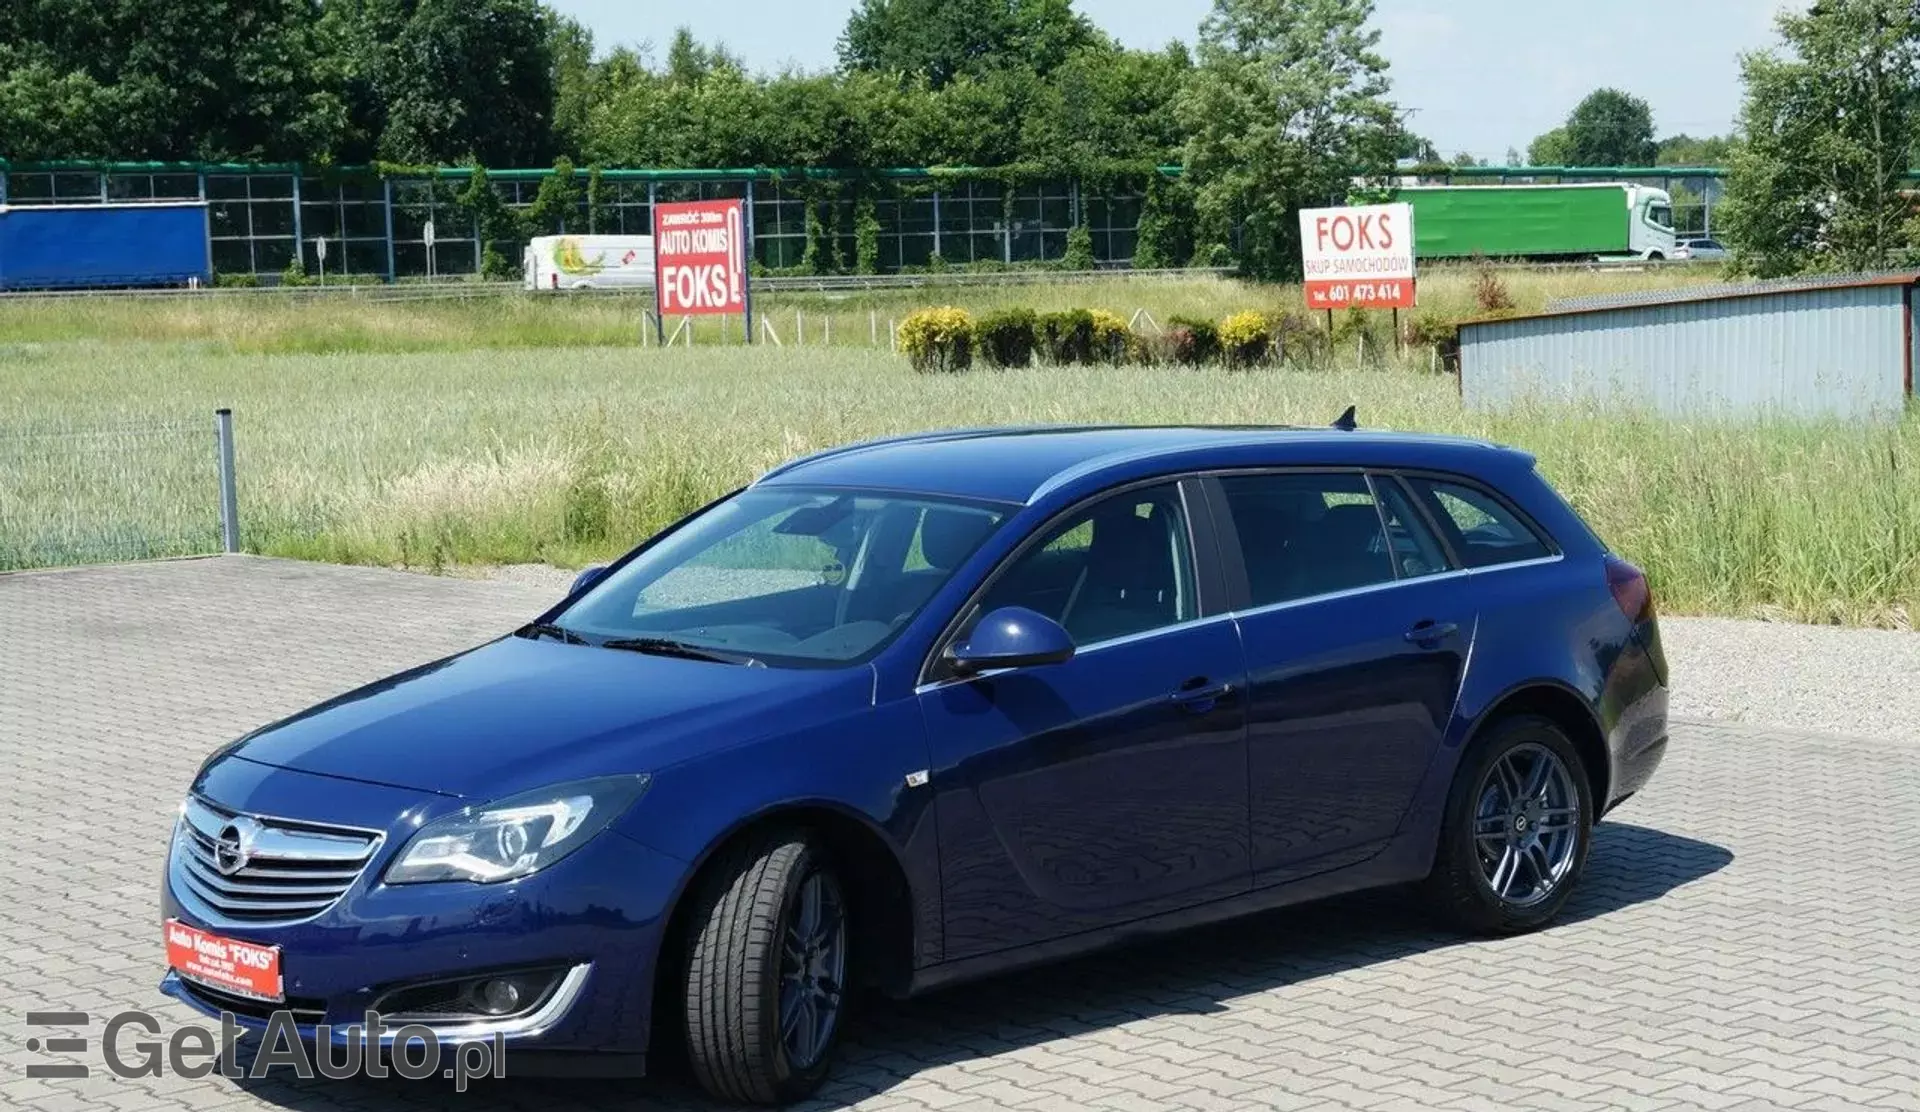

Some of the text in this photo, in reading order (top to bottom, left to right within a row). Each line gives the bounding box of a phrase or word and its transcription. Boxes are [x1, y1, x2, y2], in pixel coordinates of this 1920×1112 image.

[660, 228, 727, 255] AUTO KOMIS
[1316, 214, 1393, 252] FOKS
[1306, 254, 1409, 274] SKUP SAMOCHODÓW
[662, 264, 728, 308] FOKS
[1329, 285, 1349, 302] 601
[1353, 283, 1376, 301] 473
[1378, 283, 1401, 300] 414
[169, 926, 193, 949] Auto
[194, 932, 228, 958] Komis
